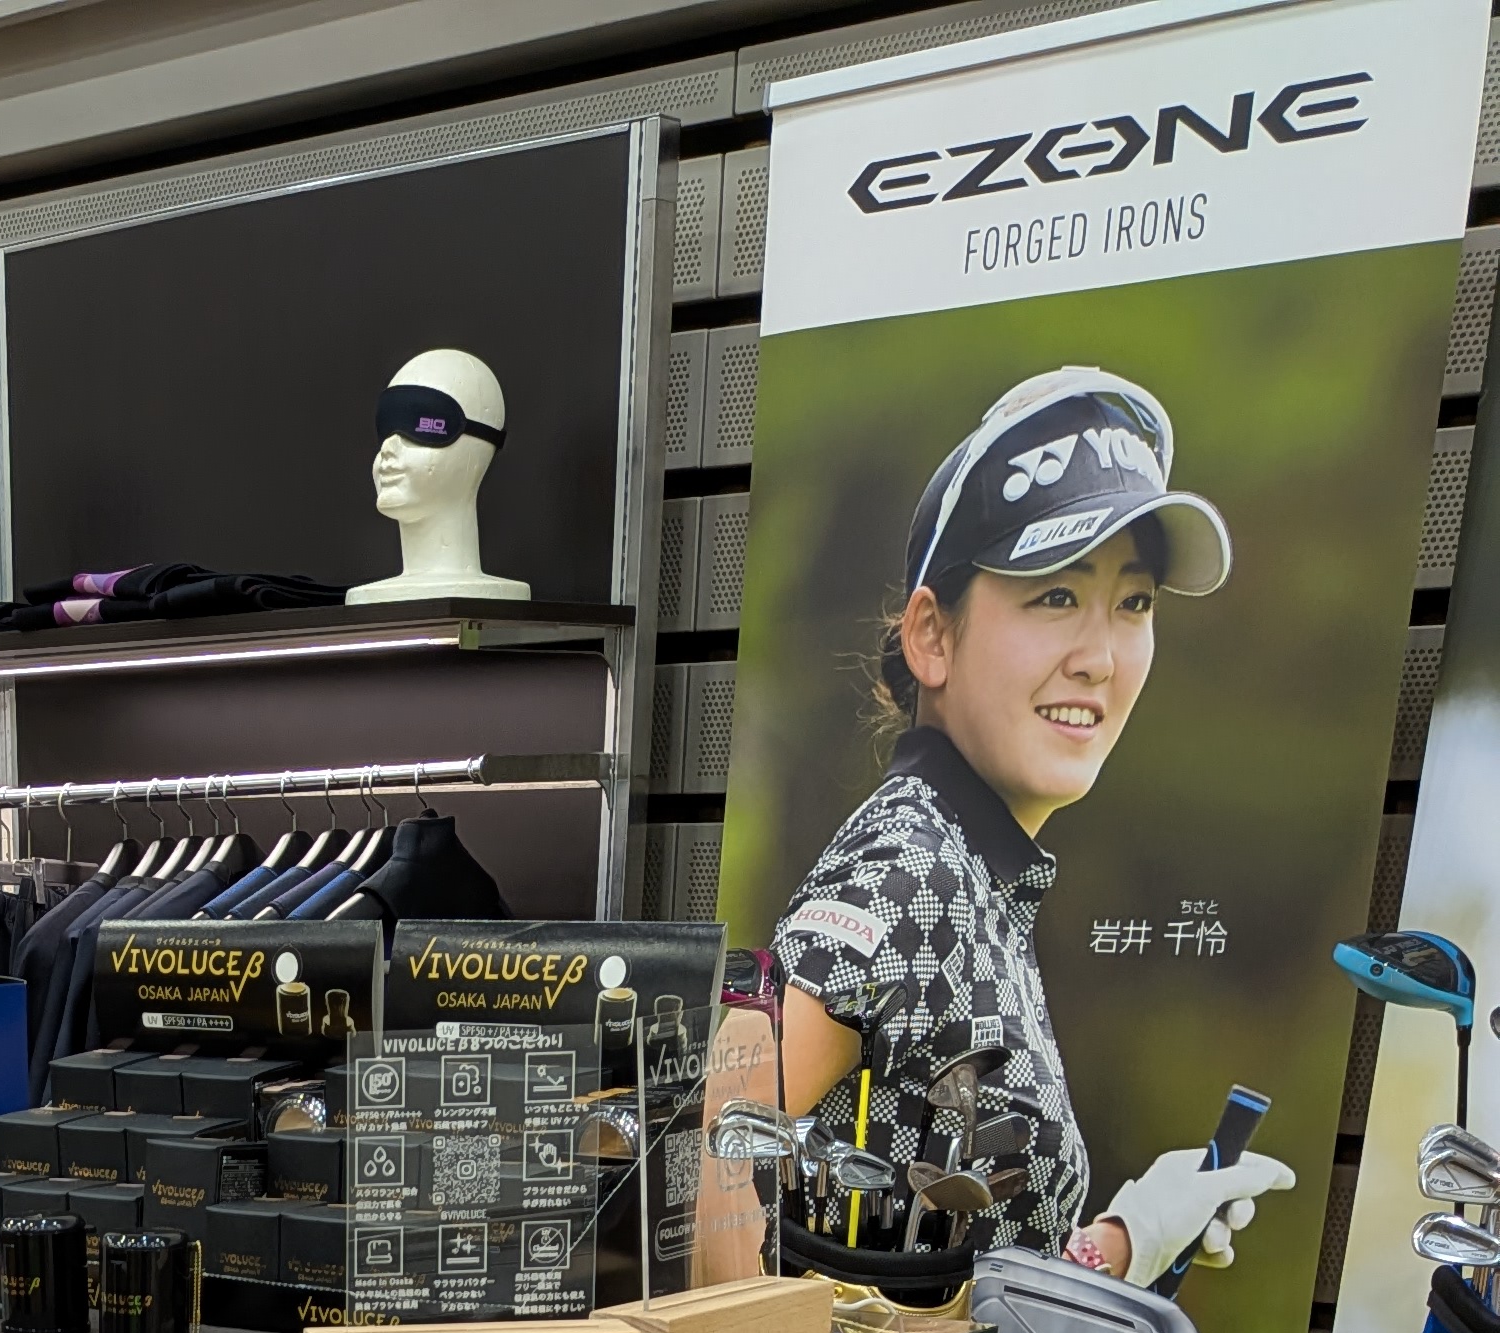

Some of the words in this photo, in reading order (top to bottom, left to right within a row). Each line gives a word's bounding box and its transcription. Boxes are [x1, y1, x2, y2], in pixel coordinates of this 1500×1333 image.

[847, 72, 1374, 214] EZONE
[964, 212, 1089, 275] FORGED
[1103, 193, 1208, 255] IRONS
[1180, 900, 1219, 916] ちさと
[795, 908, 875, 945] HONDA
[1089, 920, 1152, 956] 岩井
[1164, 918, 1229, 957] 千怜
[138, 984, 183, 1002] OSAKA
[187, 986, 230, 1003] JAPAN
[437, 991, 487, 1009] OSAKA
[493, 993, 543, 1011] JAPAN
[383, 1038, 456, 1053] VIVOLUCE
[524, 1104, 590, 1115] いつでもどこでも
[434, 1278, 496, 1288] サラサラパウダー
